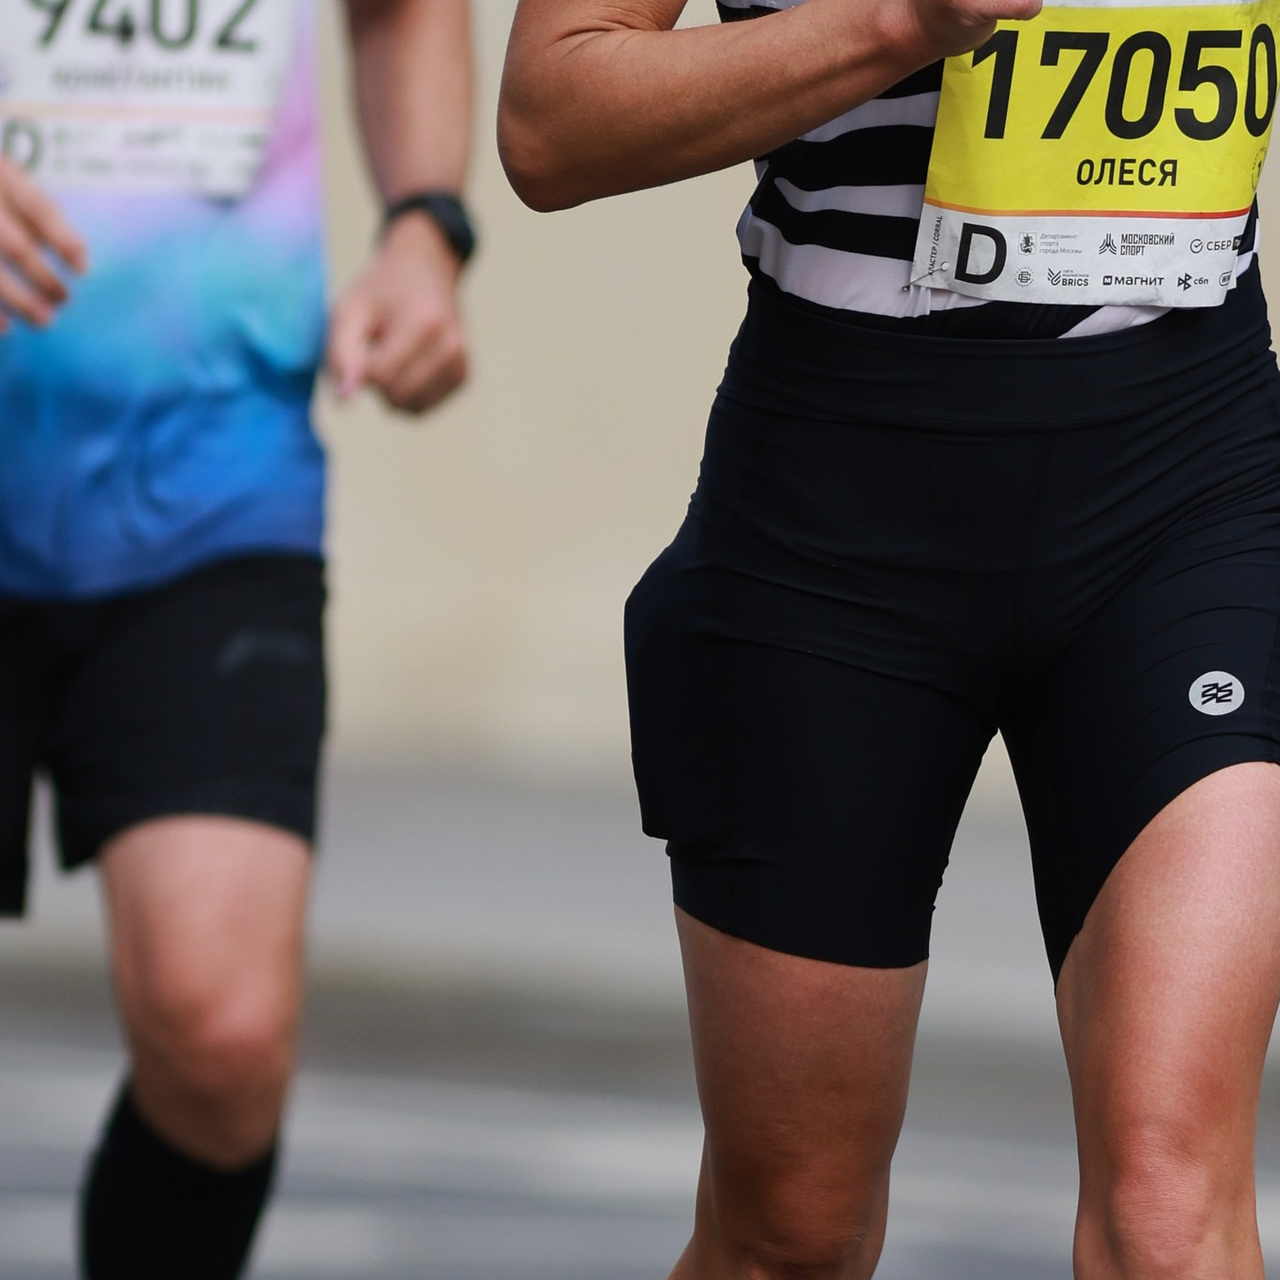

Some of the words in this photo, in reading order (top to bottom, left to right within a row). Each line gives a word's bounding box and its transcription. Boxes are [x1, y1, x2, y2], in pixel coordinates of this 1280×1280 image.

[971, 22, 1278, 142] 17050
[1076, 158, 1179, 187] ОЛЕСЯ
[933, 215, 943, 241] CORRAL
[1120, 233, 1175, 245] МОСКОВСКИЙ
[1206, 239, 1232, 251] СБЕР
[954, 222, 1007, 285] D
[1120, 245, 1145, 256] СПОРТ
[1062, 278, 1089, 287] BRICS
